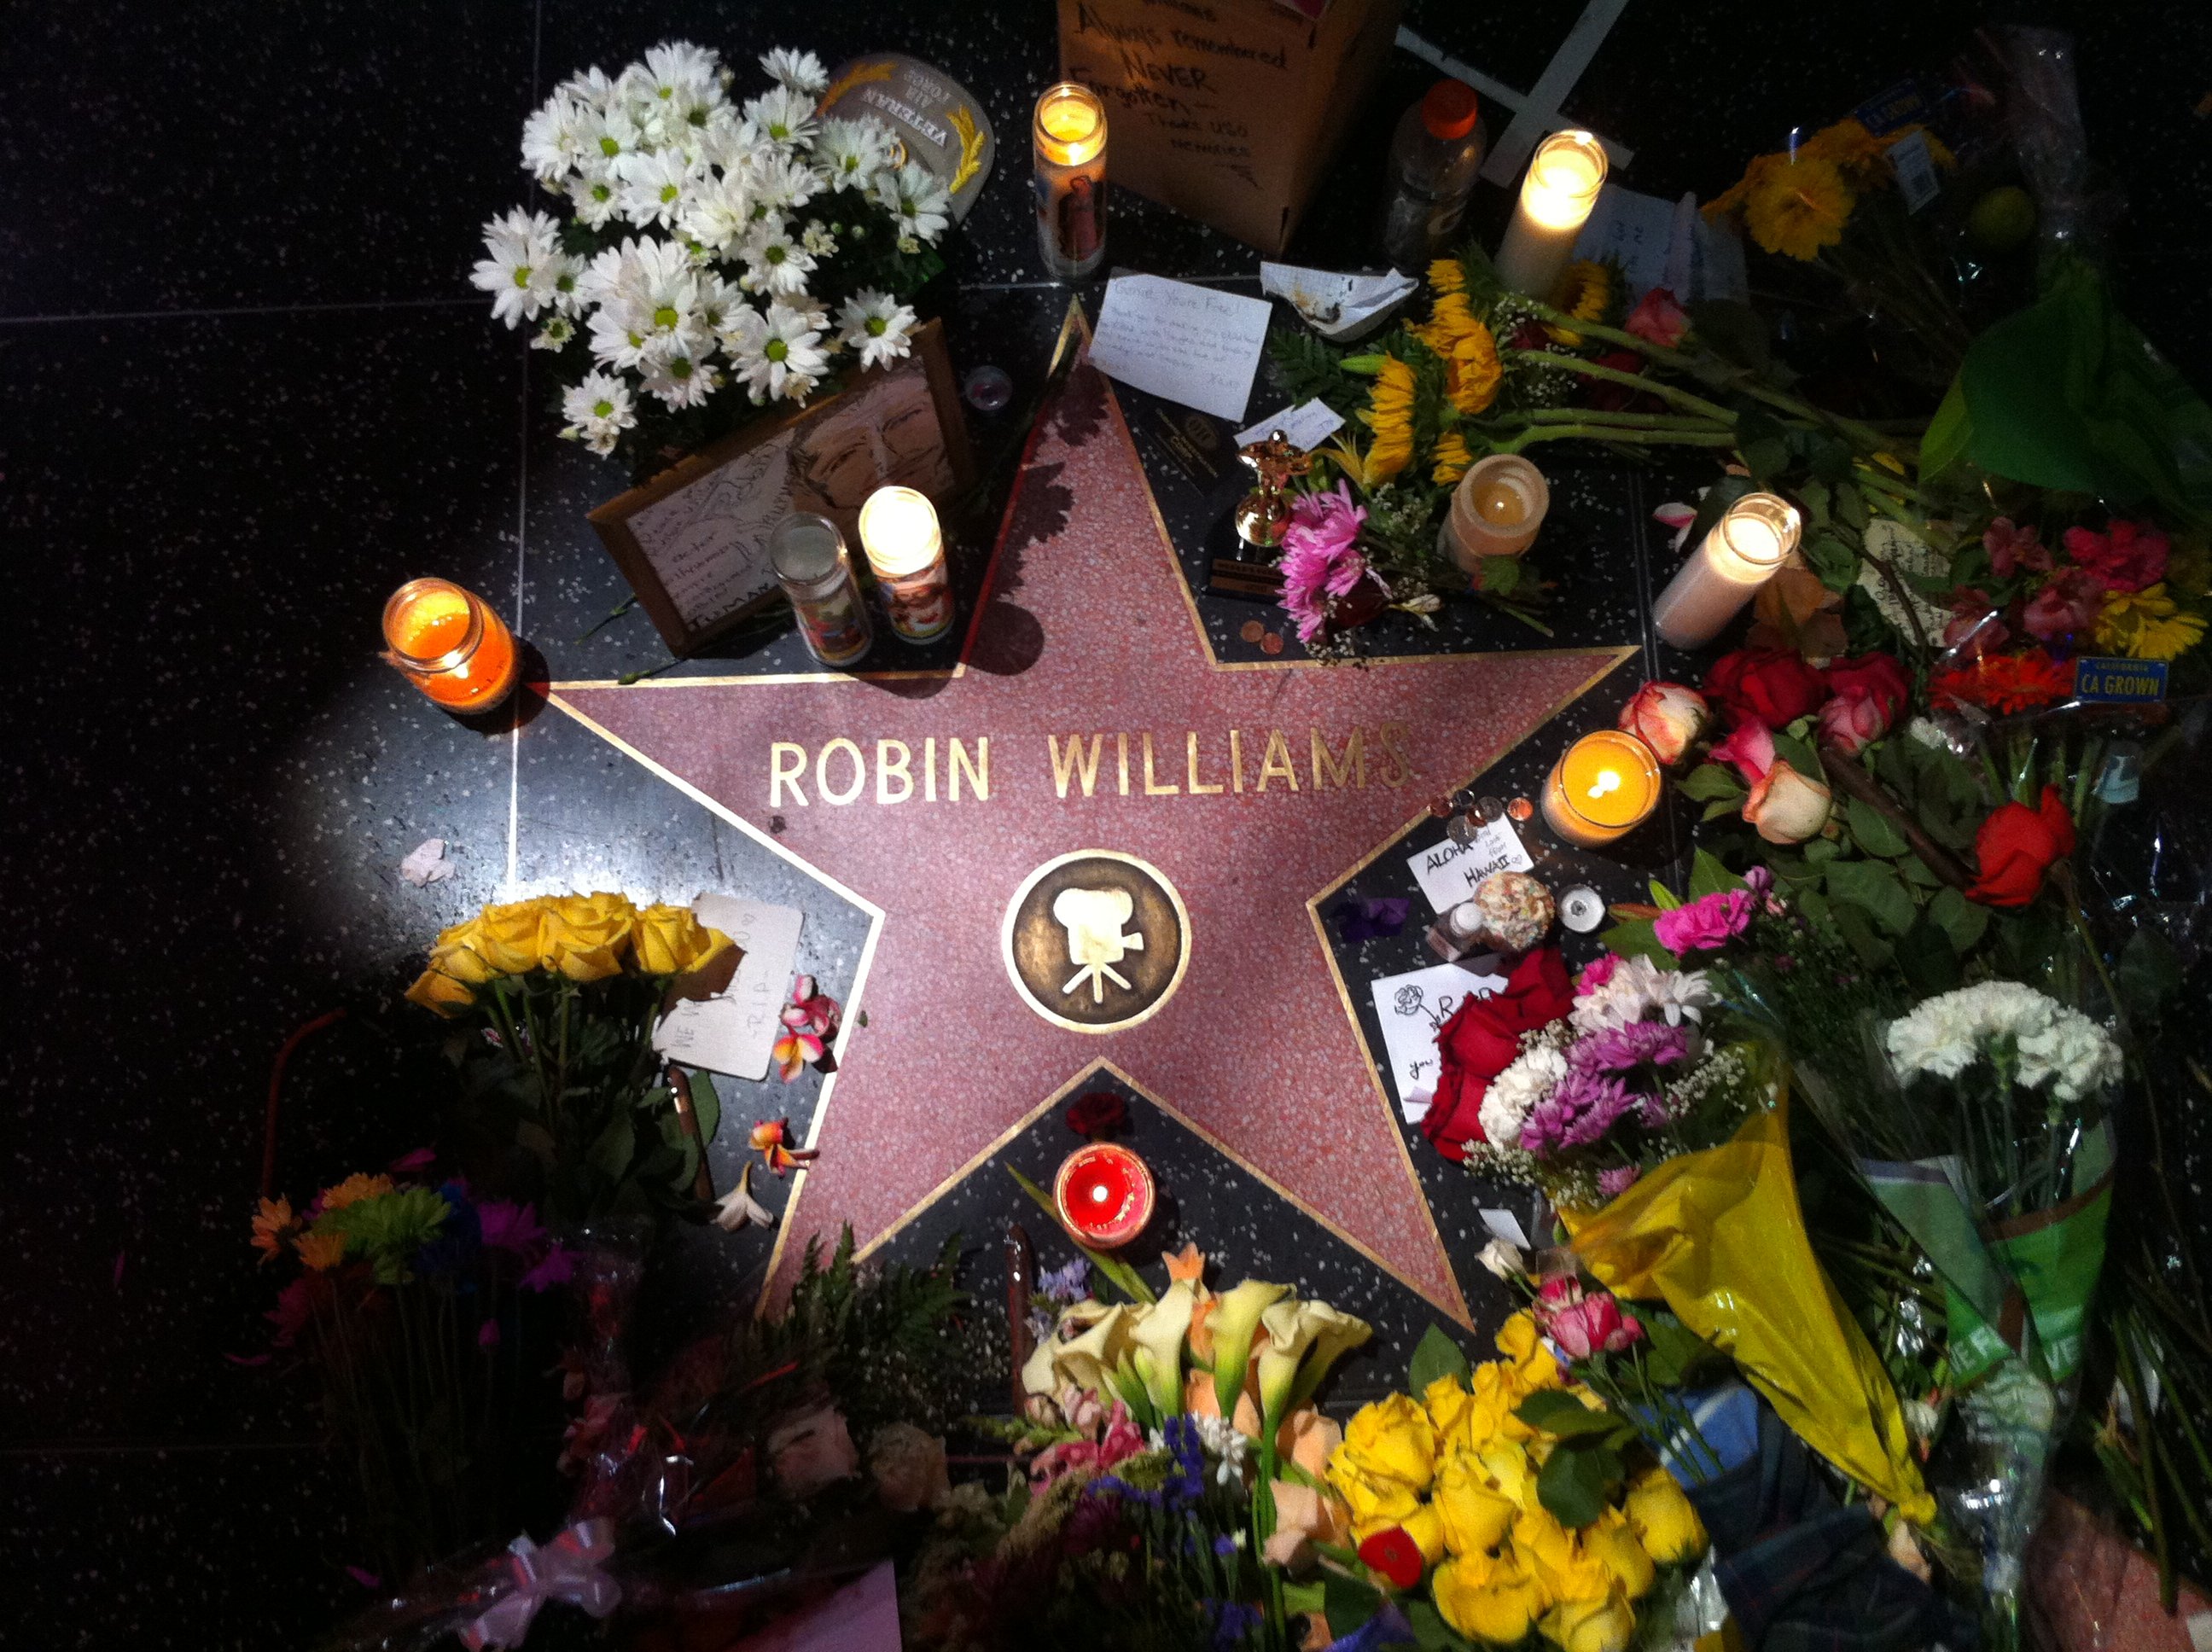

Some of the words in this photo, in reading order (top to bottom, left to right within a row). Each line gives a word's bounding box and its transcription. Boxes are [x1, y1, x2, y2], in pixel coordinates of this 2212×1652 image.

[1120, 49, 1220, 95] NEVER
[2081, 673, 2100, 694] CA
[2104, 675, 2160, 696] GROWN
[769, 736, 990, 807] ROBIN
[1046, 721, 1413, 799] WILLIAMS
[1427, 842, 1474, 875] ALOHA
[1463, 853, 1511, 887] HAWAII
